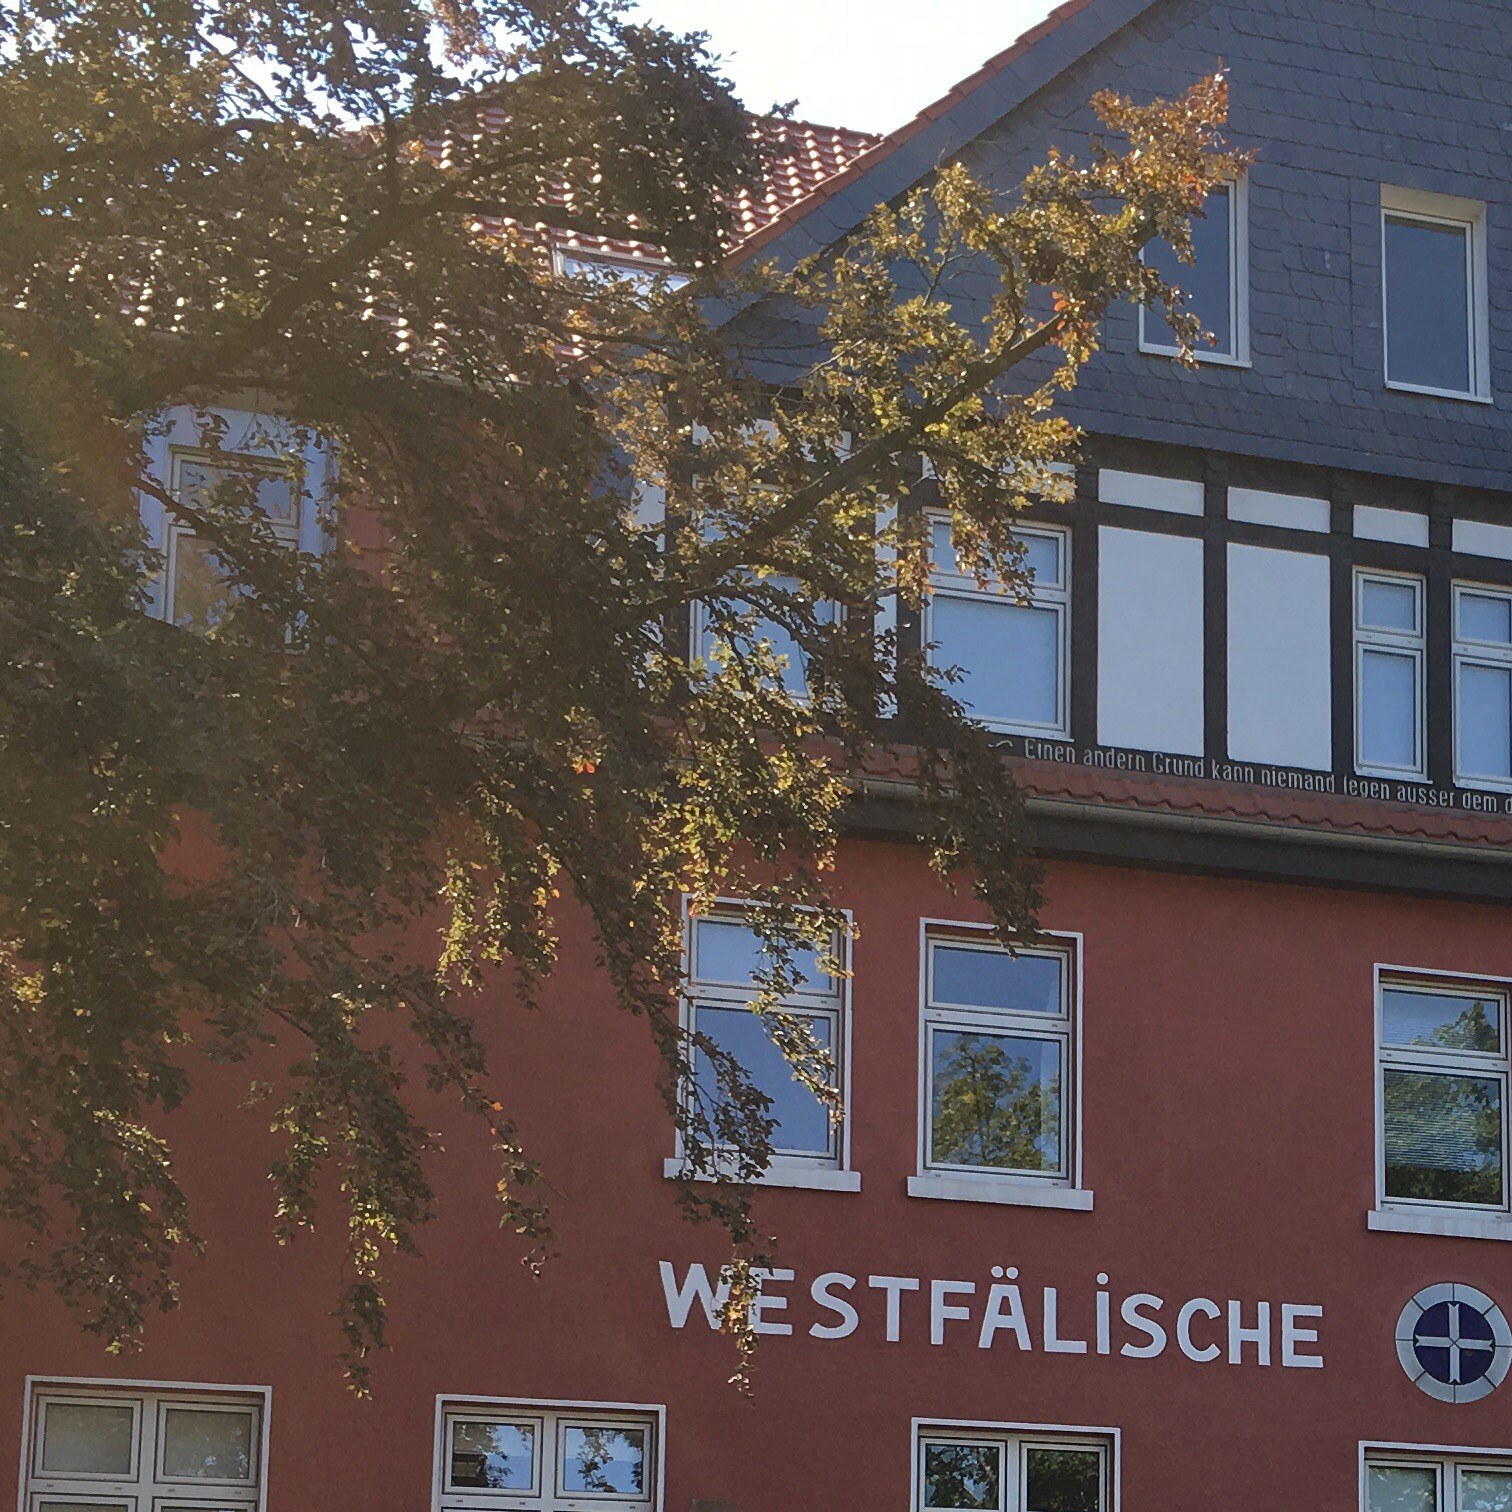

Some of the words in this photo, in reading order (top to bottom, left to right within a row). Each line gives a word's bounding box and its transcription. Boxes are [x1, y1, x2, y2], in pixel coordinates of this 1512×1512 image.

[1025, 738, 1076, 764] Einen
[1084, 748, 1146, 772] andern
[1152, 752, 1204, 778] Grund
[1211, 759, 1254, 784] kann
[1261, 766, 1335, 794] niemand
[1343, 775, 1390, 800] legen
[1397, 785, 1455, 809] ausser
